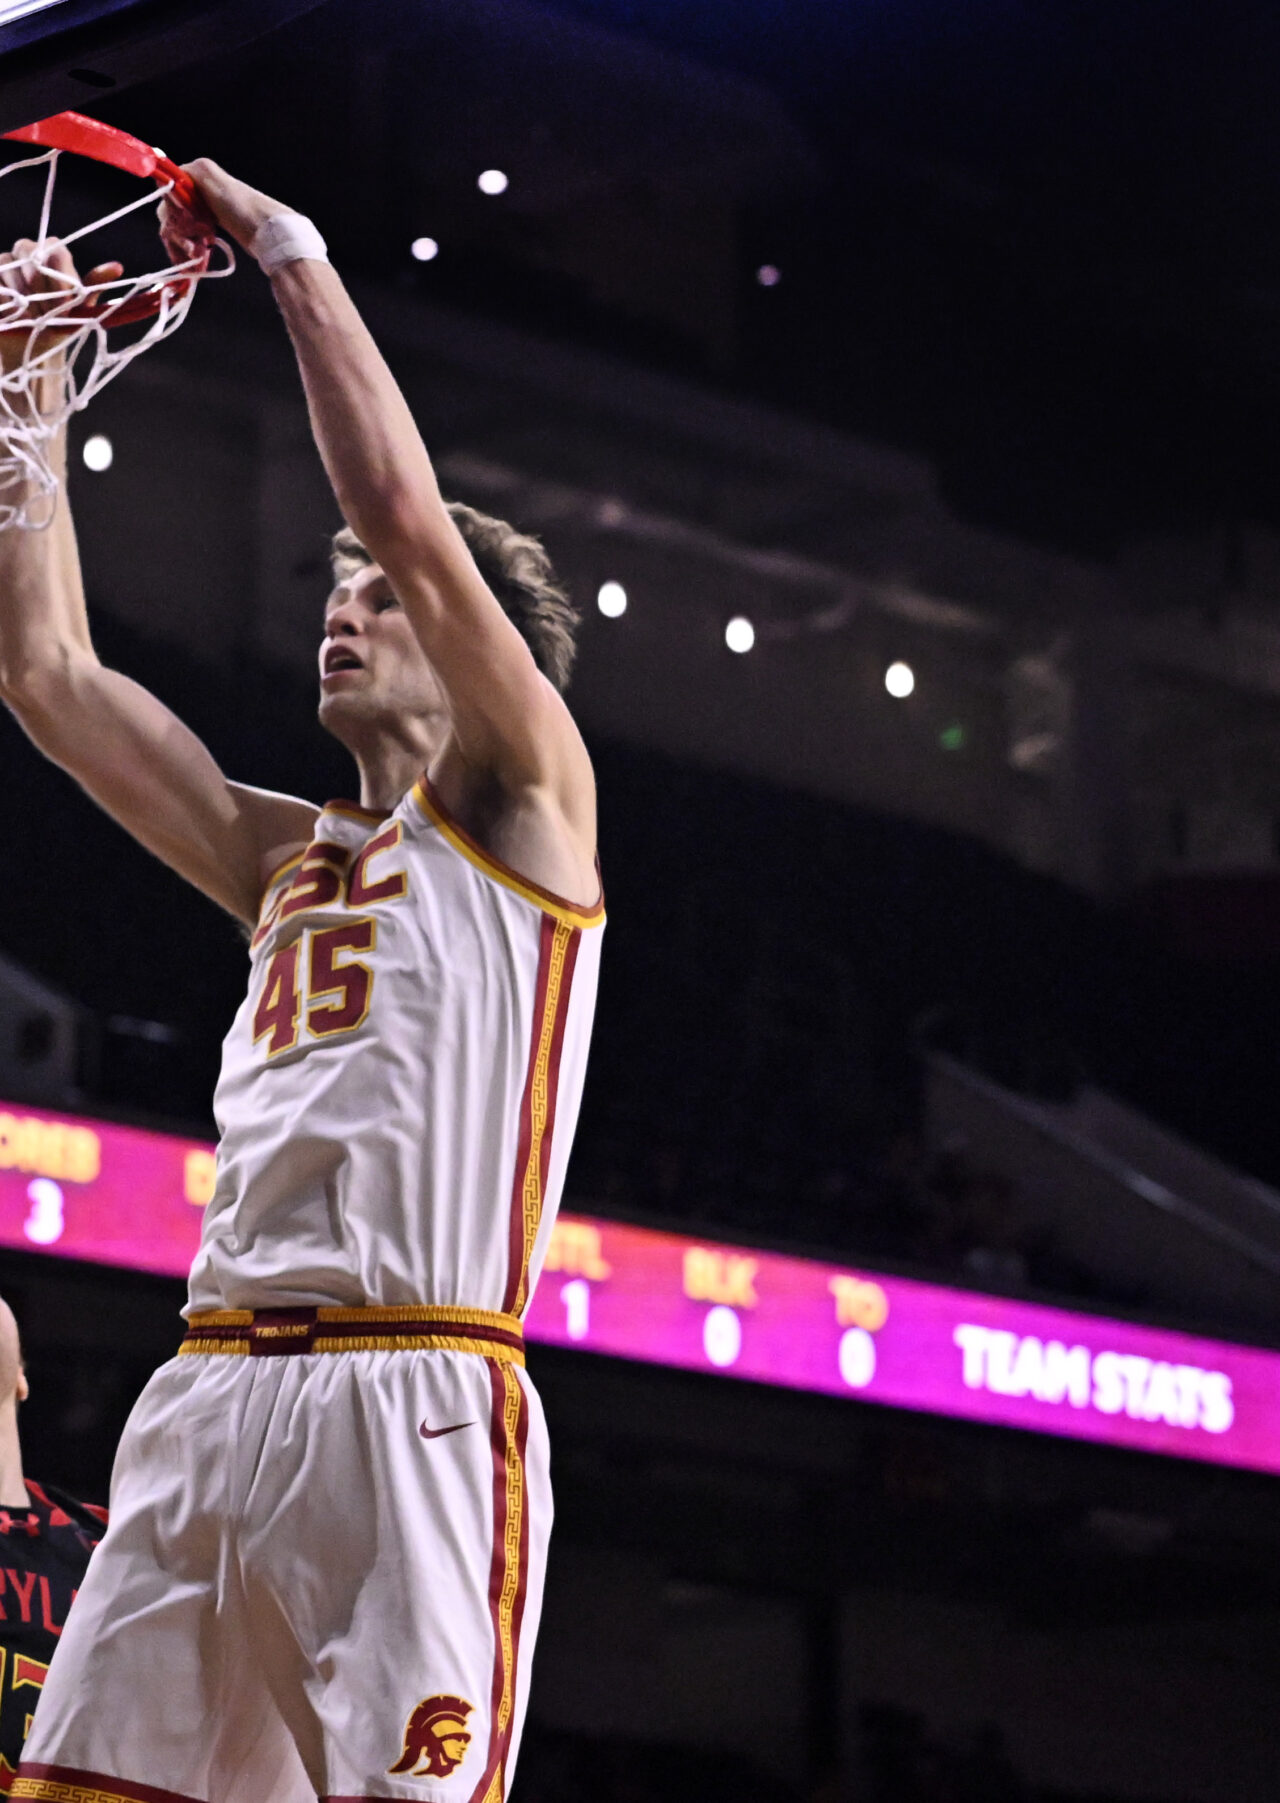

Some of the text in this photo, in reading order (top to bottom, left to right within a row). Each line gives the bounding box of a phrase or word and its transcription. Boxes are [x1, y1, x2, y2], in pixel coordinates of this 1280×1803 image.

[253, 917, 377, 1059] 45
[24, 1177, 64, 1244] 3
[255, 1324, 310, 1338] TROJANS
[560, 1278, 590, 1341] 1
[702, 1305, 742, 1368] 0
[838, 1326, 877, 1389] 0
[953, 1324, 1235, 1434] TEAM STATS
